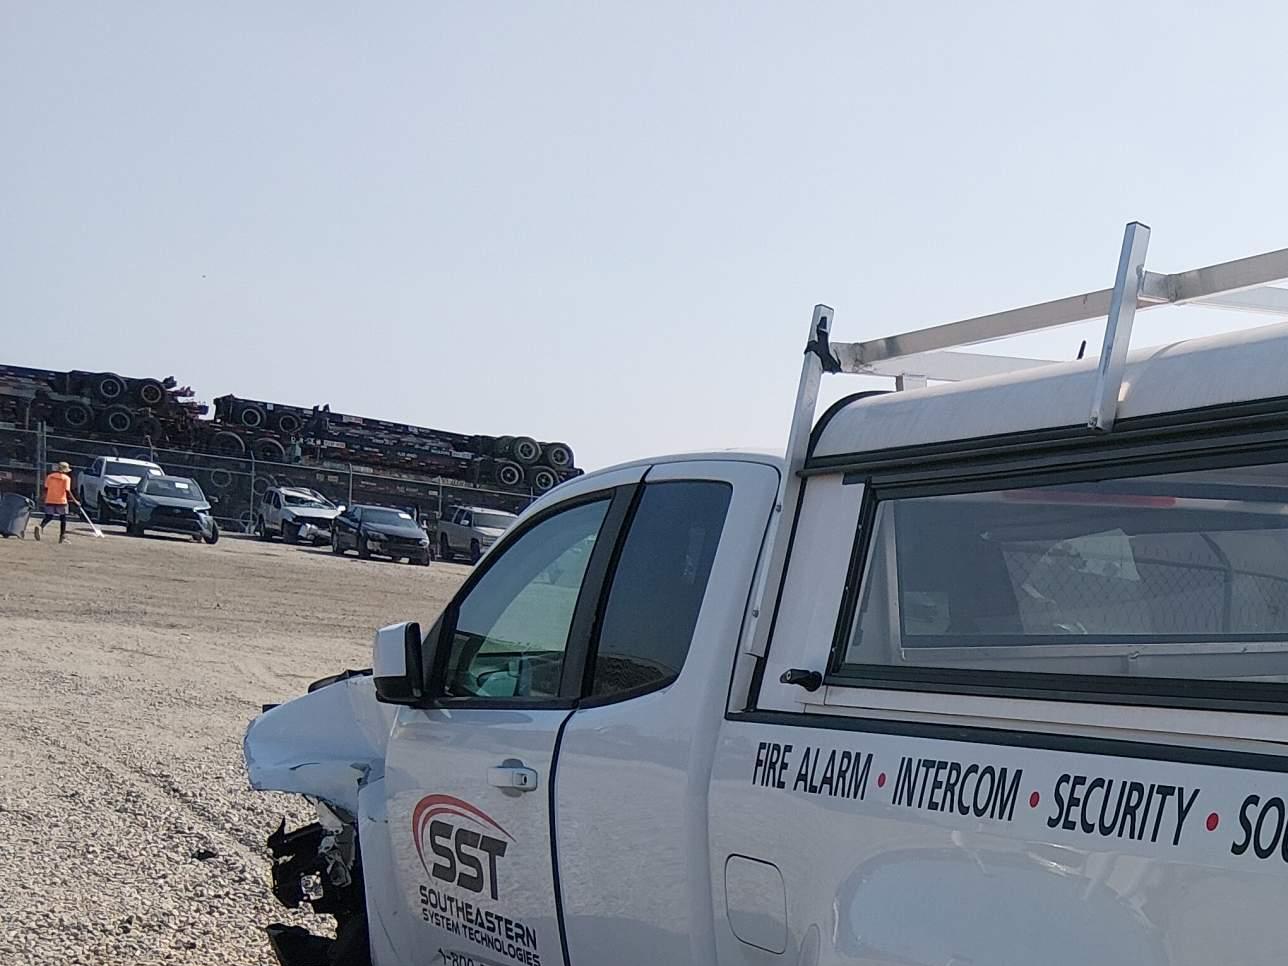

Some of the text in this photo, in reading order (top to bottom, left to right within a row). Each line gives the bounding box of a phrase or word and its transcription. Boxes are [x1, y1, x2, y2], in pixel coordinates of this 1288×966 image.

[752, 741, 793, 789] FIRE
[793, 746, 873, 801] ALARM
[891, 756, 1024, 822] INTERCOM
[1047, 773, 1201, 846] SECURITY
[429, 820, 508, 901] SST
[419, 885, 537, 949] SOUTHEASTERN
[422, 908, 461, 935] SYSTEM
